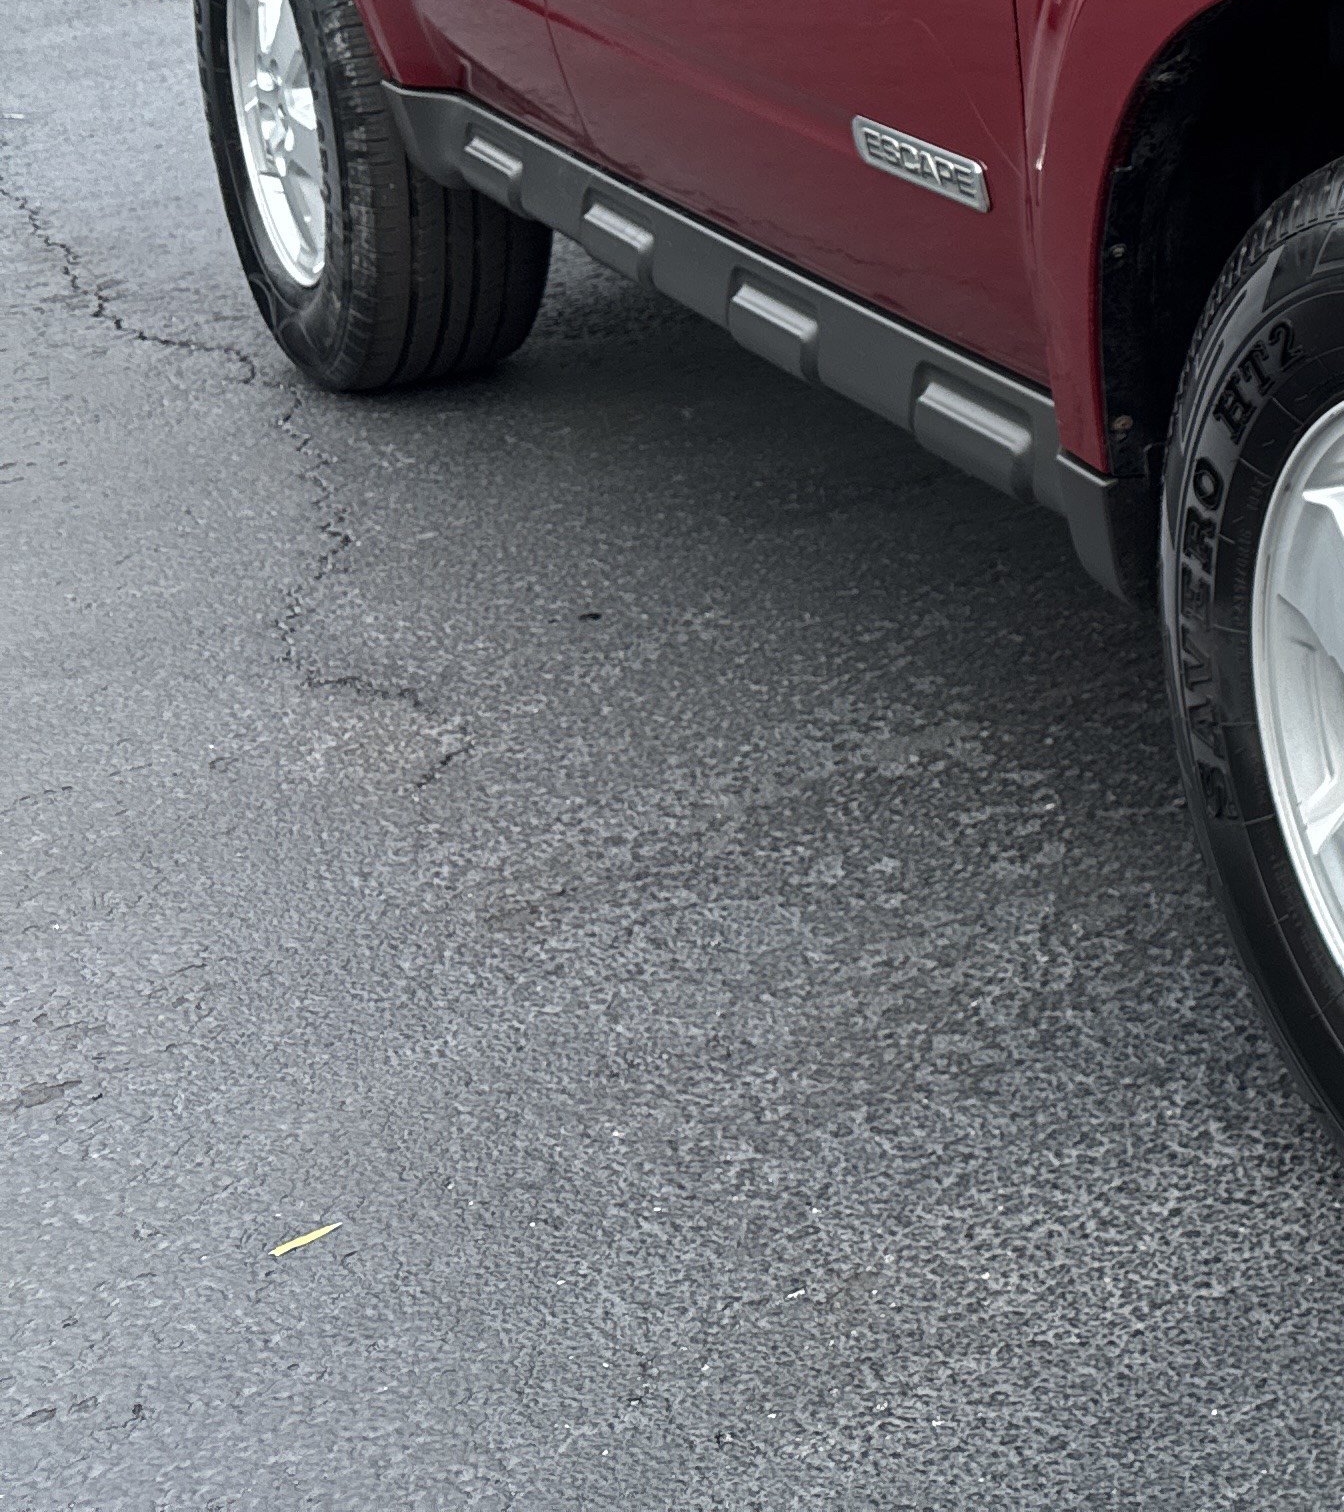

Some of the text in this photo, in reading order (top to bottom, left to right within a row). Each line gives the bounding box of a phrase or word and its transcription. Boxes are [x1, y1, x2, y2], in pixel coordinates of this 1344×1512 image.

[861, 126, 978, 199] ESCAPE
[1180, 318, 1303, 820] SAVERO HT2
